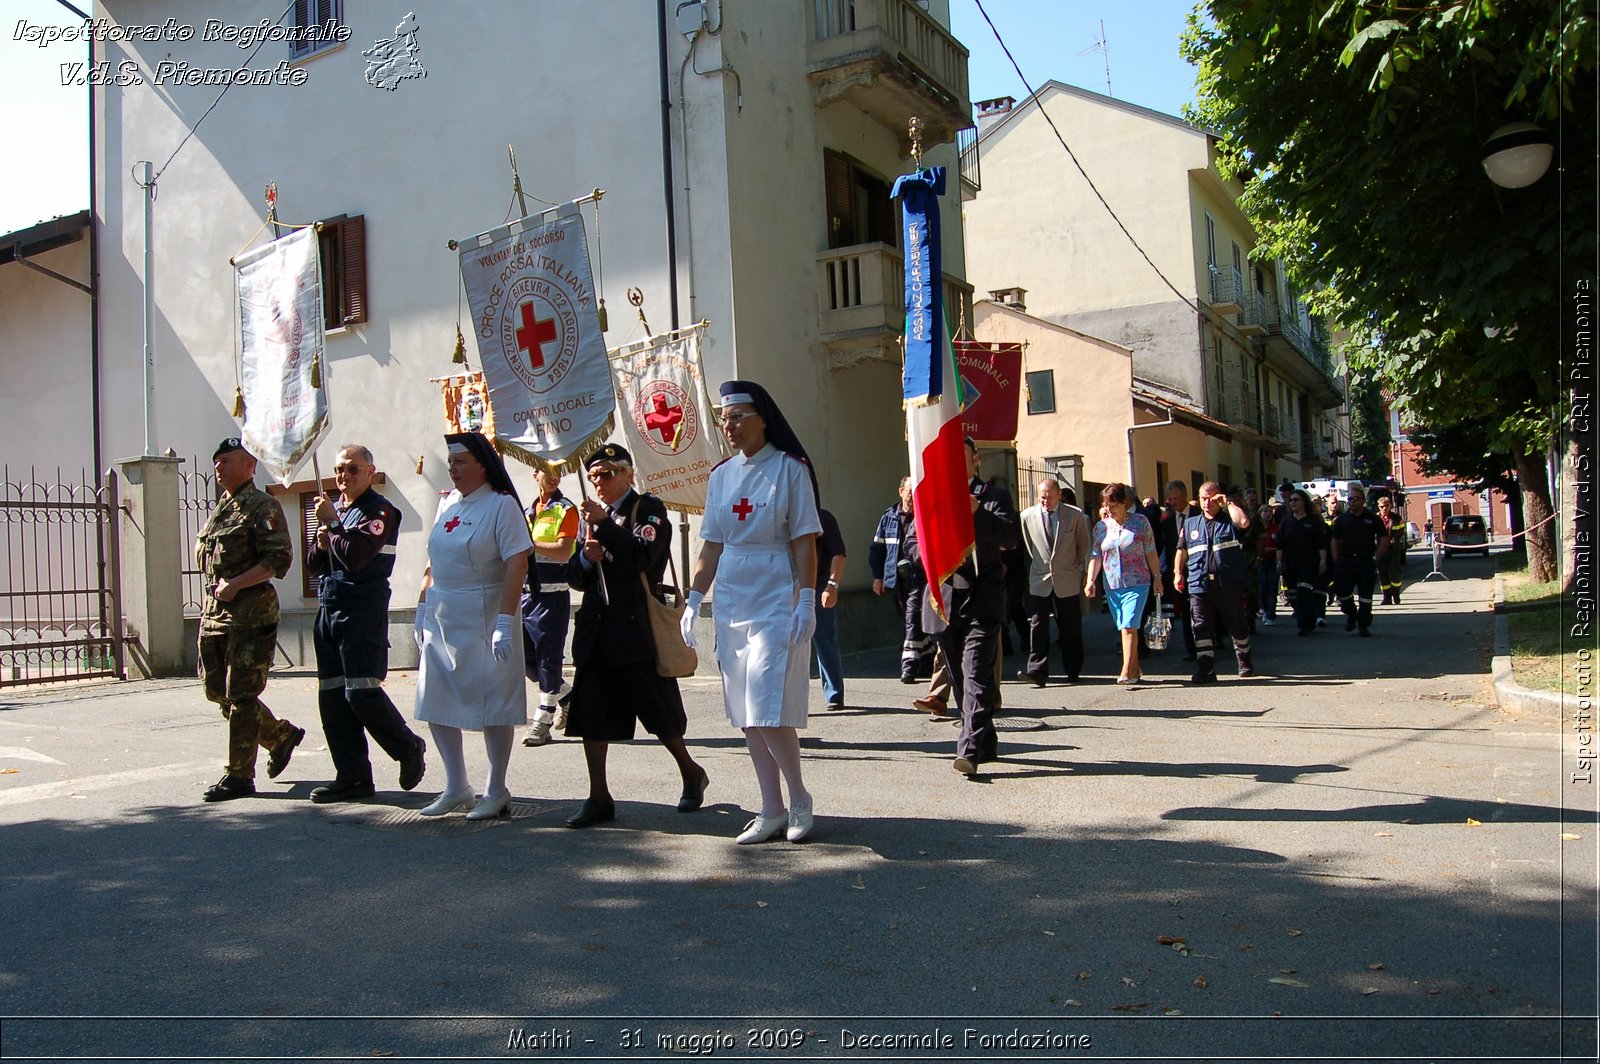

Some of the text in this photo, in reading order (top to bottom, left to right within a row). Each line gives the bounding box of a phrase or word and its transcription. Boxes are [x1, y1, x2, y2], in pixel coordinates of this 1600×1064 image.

[513, 243, 526, 255] DEL
[530, 230, 565, 249] SOCCORSO
[481, 255, 590, 339] CROCE ROSSA ITALIANA
[512, 280, 551, 298] GINEVRA
[552, 293, 567, 309] 22
[562, 310, 576, 357] AGOSTO
[617, 371, 635, 400] CROCE
[513, 394, 596, 423] COMITATO LOCALE
[536, 418, 573, 440] FIANO
[646, 466, 686, 482] COMITATO
